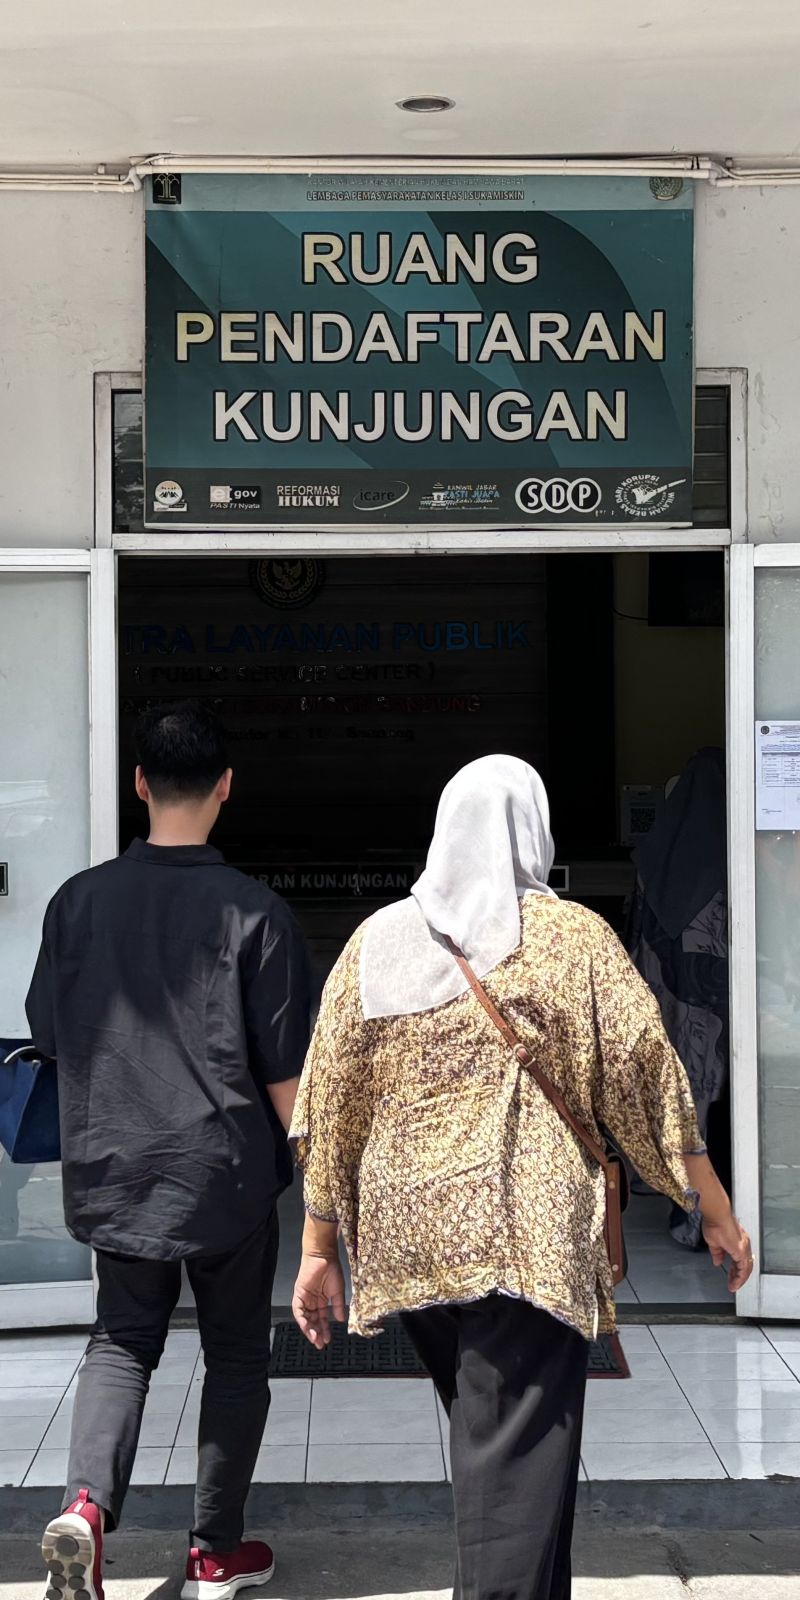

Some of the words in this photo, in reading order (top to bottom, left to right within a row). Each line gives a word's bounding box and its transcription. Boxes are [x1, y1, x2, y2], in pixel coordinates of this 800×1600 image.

[306, 191, 350, 201] LEMBAGA
[351, 191, 434, 201] PEMASYARAKATAN
[435, 191, 462, 201] KELAS
[469, 191, 525, 201] SUKAMISKIN
[301, 231, 539, 285] RUANG
[174, 309, 667, 364] PENDAFTARAN
[212, 388, 629, 442] KUNJUNGAN
[621, 474, 660, 487] KORUPSI
[234, 489, 257, 500] gov
[276, 485, 340, 496] REFORMASI
[359, 488, 395, 501] icare
[615, 486, 624, 504] DARI
[278, 495, 340, 507] HUKUM
[649, 491, 675, 516] WILAYAH
[207, 623, 381, 655] LAYANAN
[393, 621, 533, 654] PUBLIK
[151, 665, 227, 682] PUBLIC
[236, 663, 329, 682] SERVICE
[336, 663, 422, 681] CENTER
[300, 872, 408, 889] KUNJUNGAN
